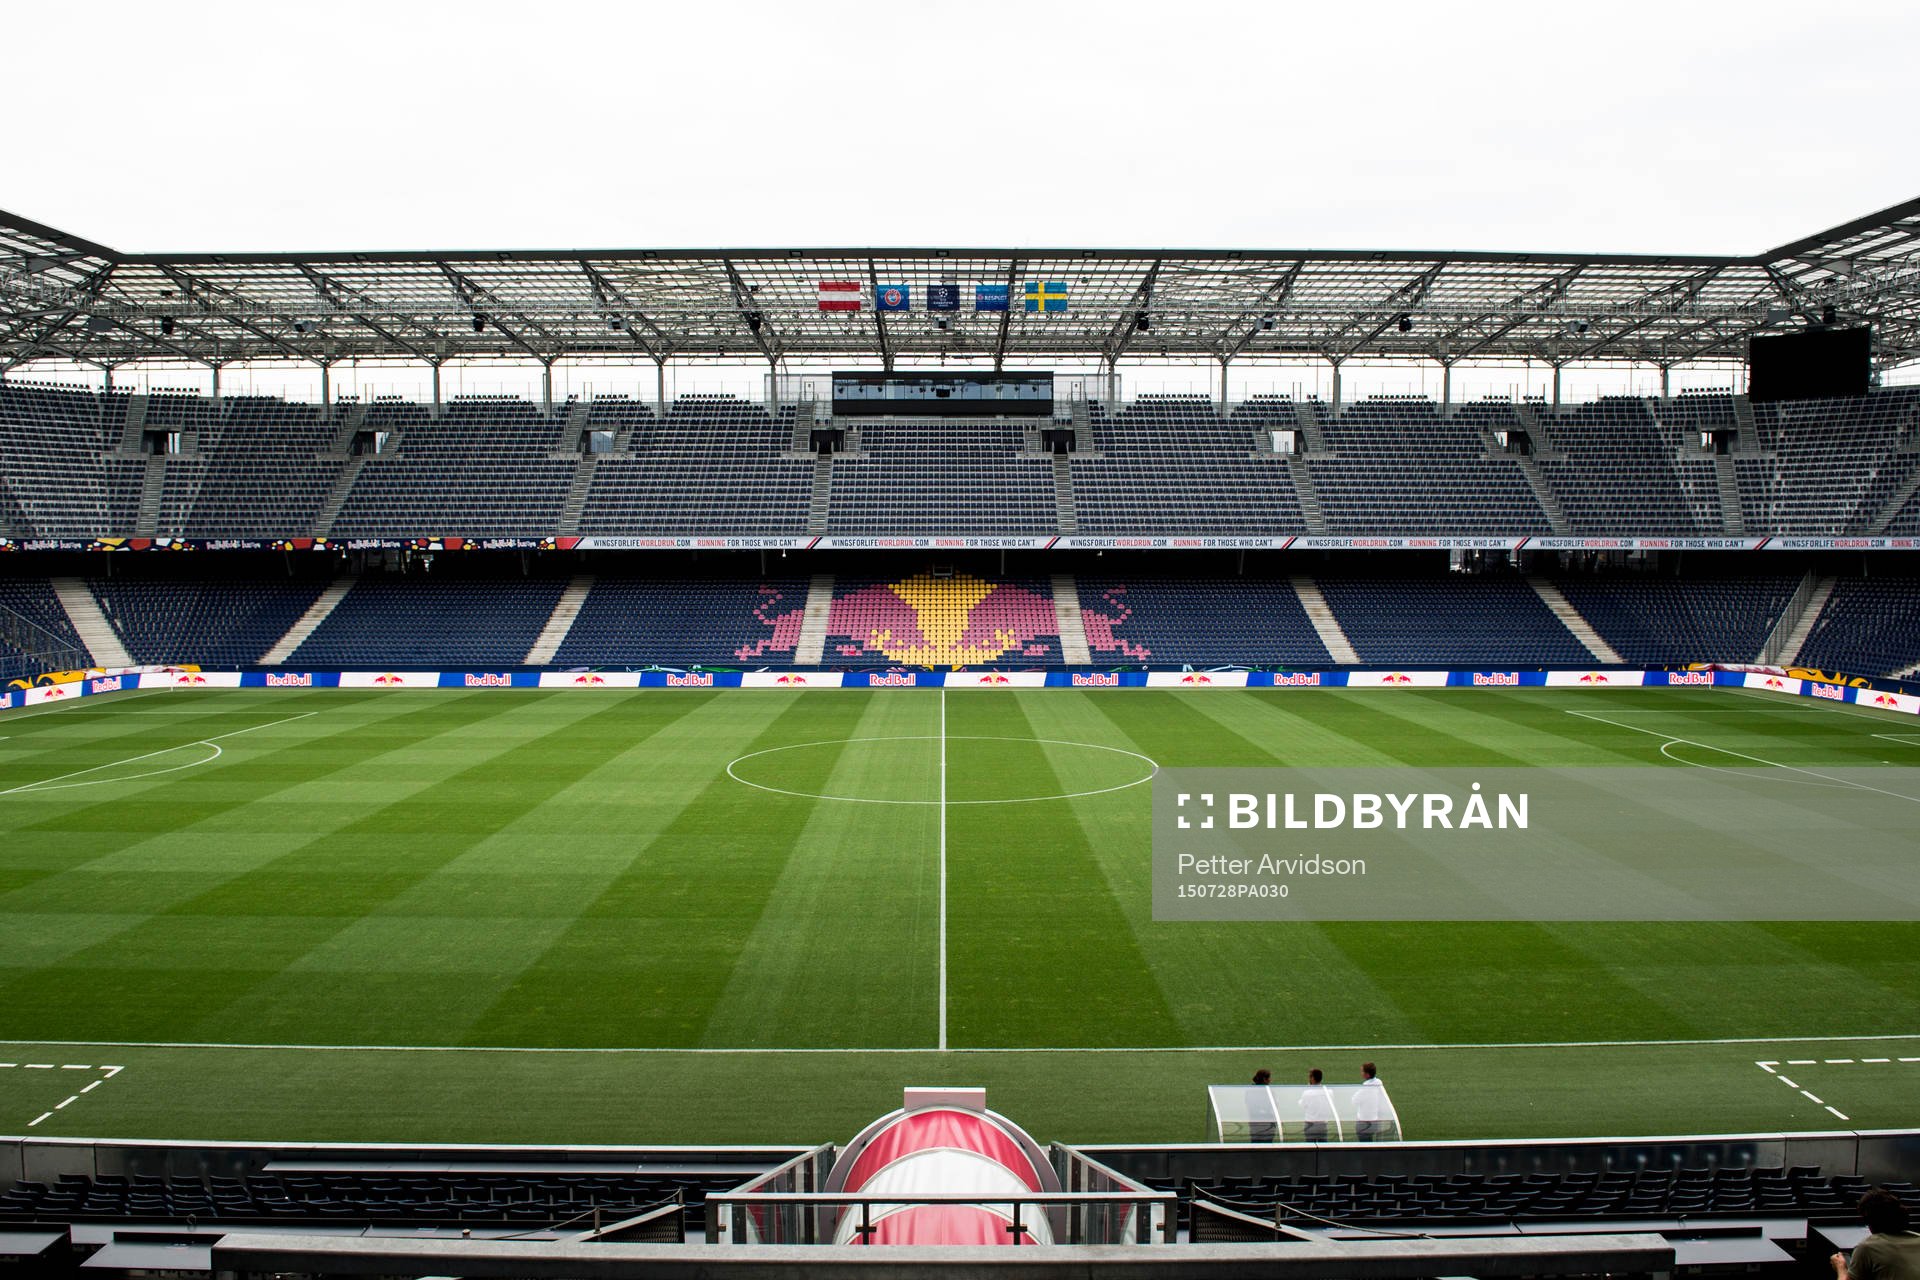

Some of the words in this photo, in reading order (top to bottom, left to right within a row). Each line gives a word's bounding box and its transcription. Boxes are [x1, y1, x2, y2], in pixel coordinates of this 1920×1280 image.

[594, 539, 691, 547] WINGSFORLIFEWORLDRUN.COM
[698, 539, 725, 547] RUNNING
[727, 539, 740, 547] FOR
[742, 539, 761, 547] THOSE
[763, 539, 777, 547] WHO
[779, 539, 797, 547] CAN'T
[832, 539, 929, 547] WINGSFORLIFEWORLDRUN.COM
[936, 539, 964, 547] RUNNING
[966, 539, 978, 547] FOR
[980, 539, 999, 547] THOSE
[1001, 539, 1016, 547] WHO
[1018, 539, 1035, 547] CAN'T
[1070, 539, 1167, 547] WINGSFORLIFEWORLDRUN.COM
[1174, 539, 1201, 547] RUNNING
[1204, 539, 1215, 547] FOR
[1218, 539, 1237, 547] THOSE
[1239, 539, 1253, 547] WHO
[1255, 539, 1273, 547] CAN'T
[1307, 539, 1403, 547] WINGSFORLIFEWORLDRUN.COM
[1409, 539, 1437, 547] RUNNING
[1439, 539, 1451, 547] FOR
[1453, 539, 1471, 547] THOSE
[1473, 539, 1487, 547] WHO
[1489, 539, 1506, 547] CAN'T
[1540, 539, 1633, 547] WINGSFORLIFEWORLDRUN.COM
[1640, 539, 1668, 547] RUNNING
[1671, 539, 1683, 547] FOR
[1685, 539, 1704, 547] THOSE
[1707, 539, 1722, 547] WHO
[1725, 539, 1744, 547] CAN'T
[1782, 539, 1886, 548] WINGSFORLIFEWORLDRUN.COM
[266, 673, 289, 686] Red
[289, 673, 312, 686] Bull
[464, 673, 488, 686] Red
[488, 673, 511, 686] Bull
[667, 673, 690, 686] Red
[690, 673, 713, 686] Bull
[869, 673, 893, 686] Red
[893, 673, 915, 686] Bull
[1072, 673, 1095, 686] Red
[1095, 673, 1118, 686] Bull
[1273, 673, 1297, 686] Red
[1297, 673, 1320, 686] Bull
[1473, 673, 1496, 686] Red
[1496, 673, 1519, 686] Bull
[1669, 673, 1691, 686] Red
